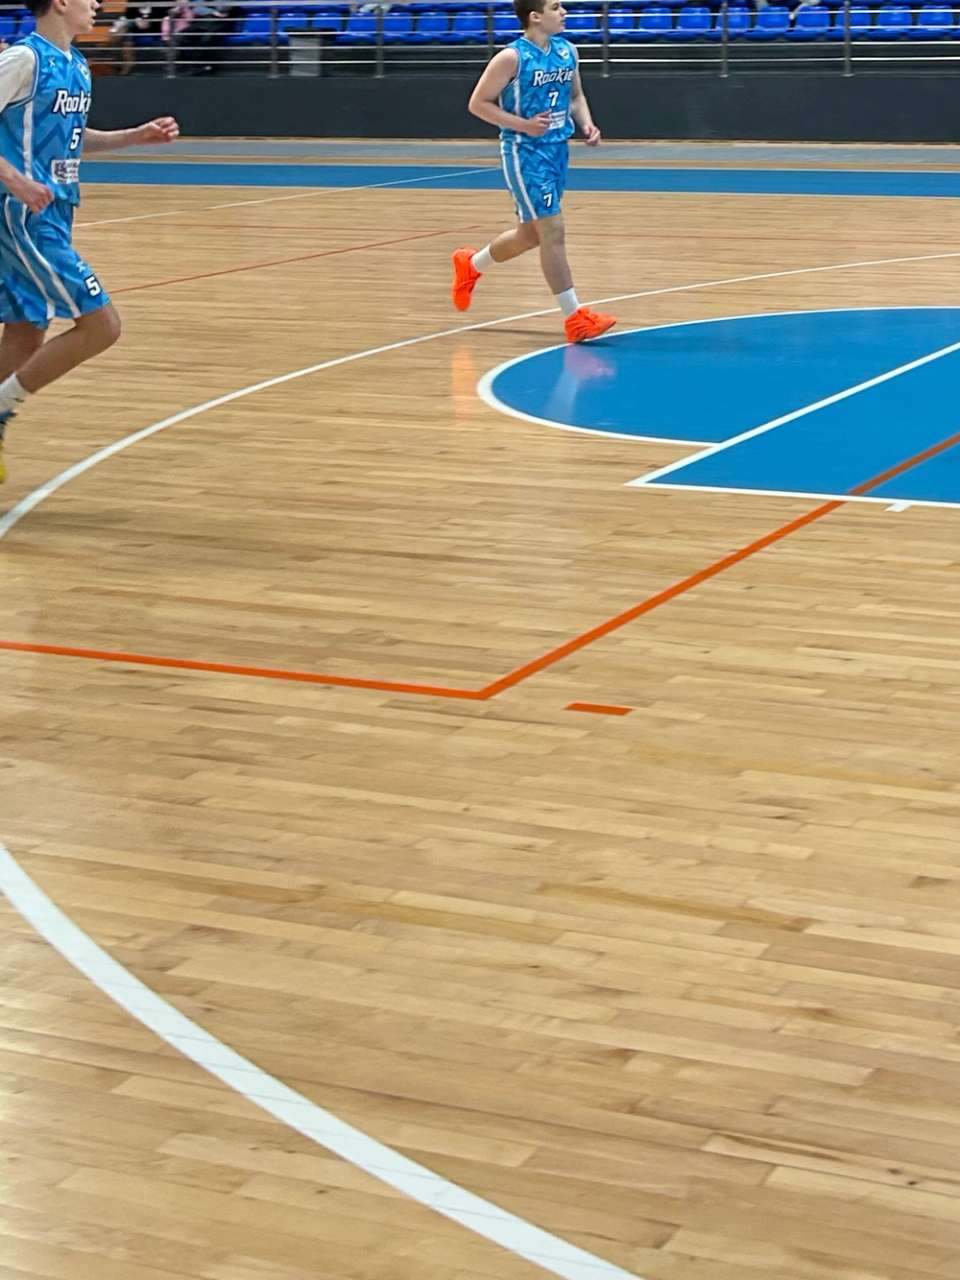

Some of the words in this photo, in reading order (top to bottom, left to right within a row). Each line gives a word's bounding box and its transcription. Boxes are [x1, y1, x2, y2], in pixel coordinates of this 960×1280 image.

[532, 70, 574, 87] Rookie
[548, 91, 559, 107] 7
[69, 126, 82, 150] 5
[543, 193, 553, 207] 7
[85, 275, 101, 297] 5
